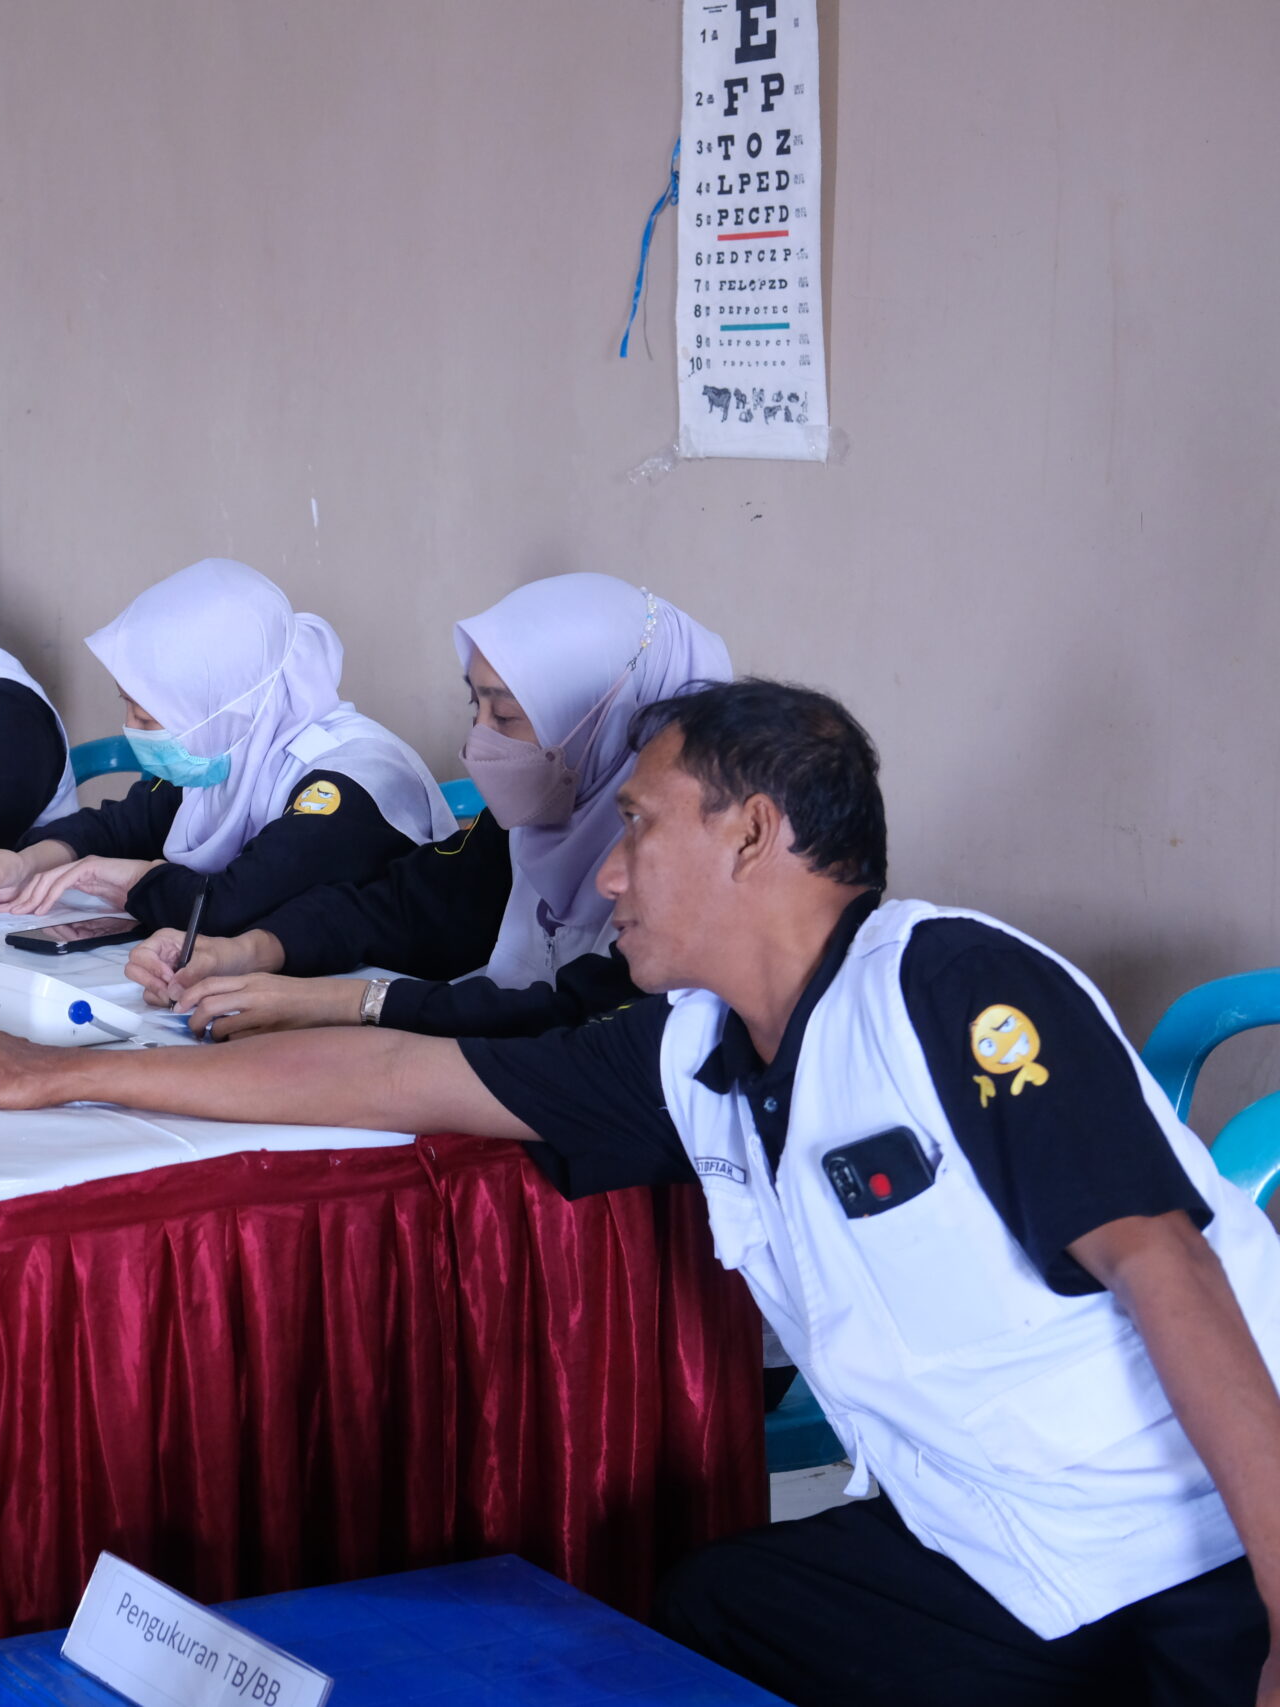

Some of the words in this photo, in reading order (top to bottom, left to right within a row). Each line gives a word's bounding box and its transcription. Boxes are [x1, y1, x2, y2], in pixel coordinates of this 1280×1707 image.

[735, 0, 776, 64] E
[695, 91, 703, 107] 2
[696, 139, 703, 155] 3
[696, 181, 703, 196] 4
[695, 213, 703, 228] 5
[695, 252, 703, 267] 6
[694, 278, 702, 294] 7
[693, 303, 702, 318] 8
[695, 334, 703, 349] 9
[690, 356, 703, 371] 10
[116, 1592, 221, 1673] Pengukuran
[223, 1653, 282, 1707] TB/BB
